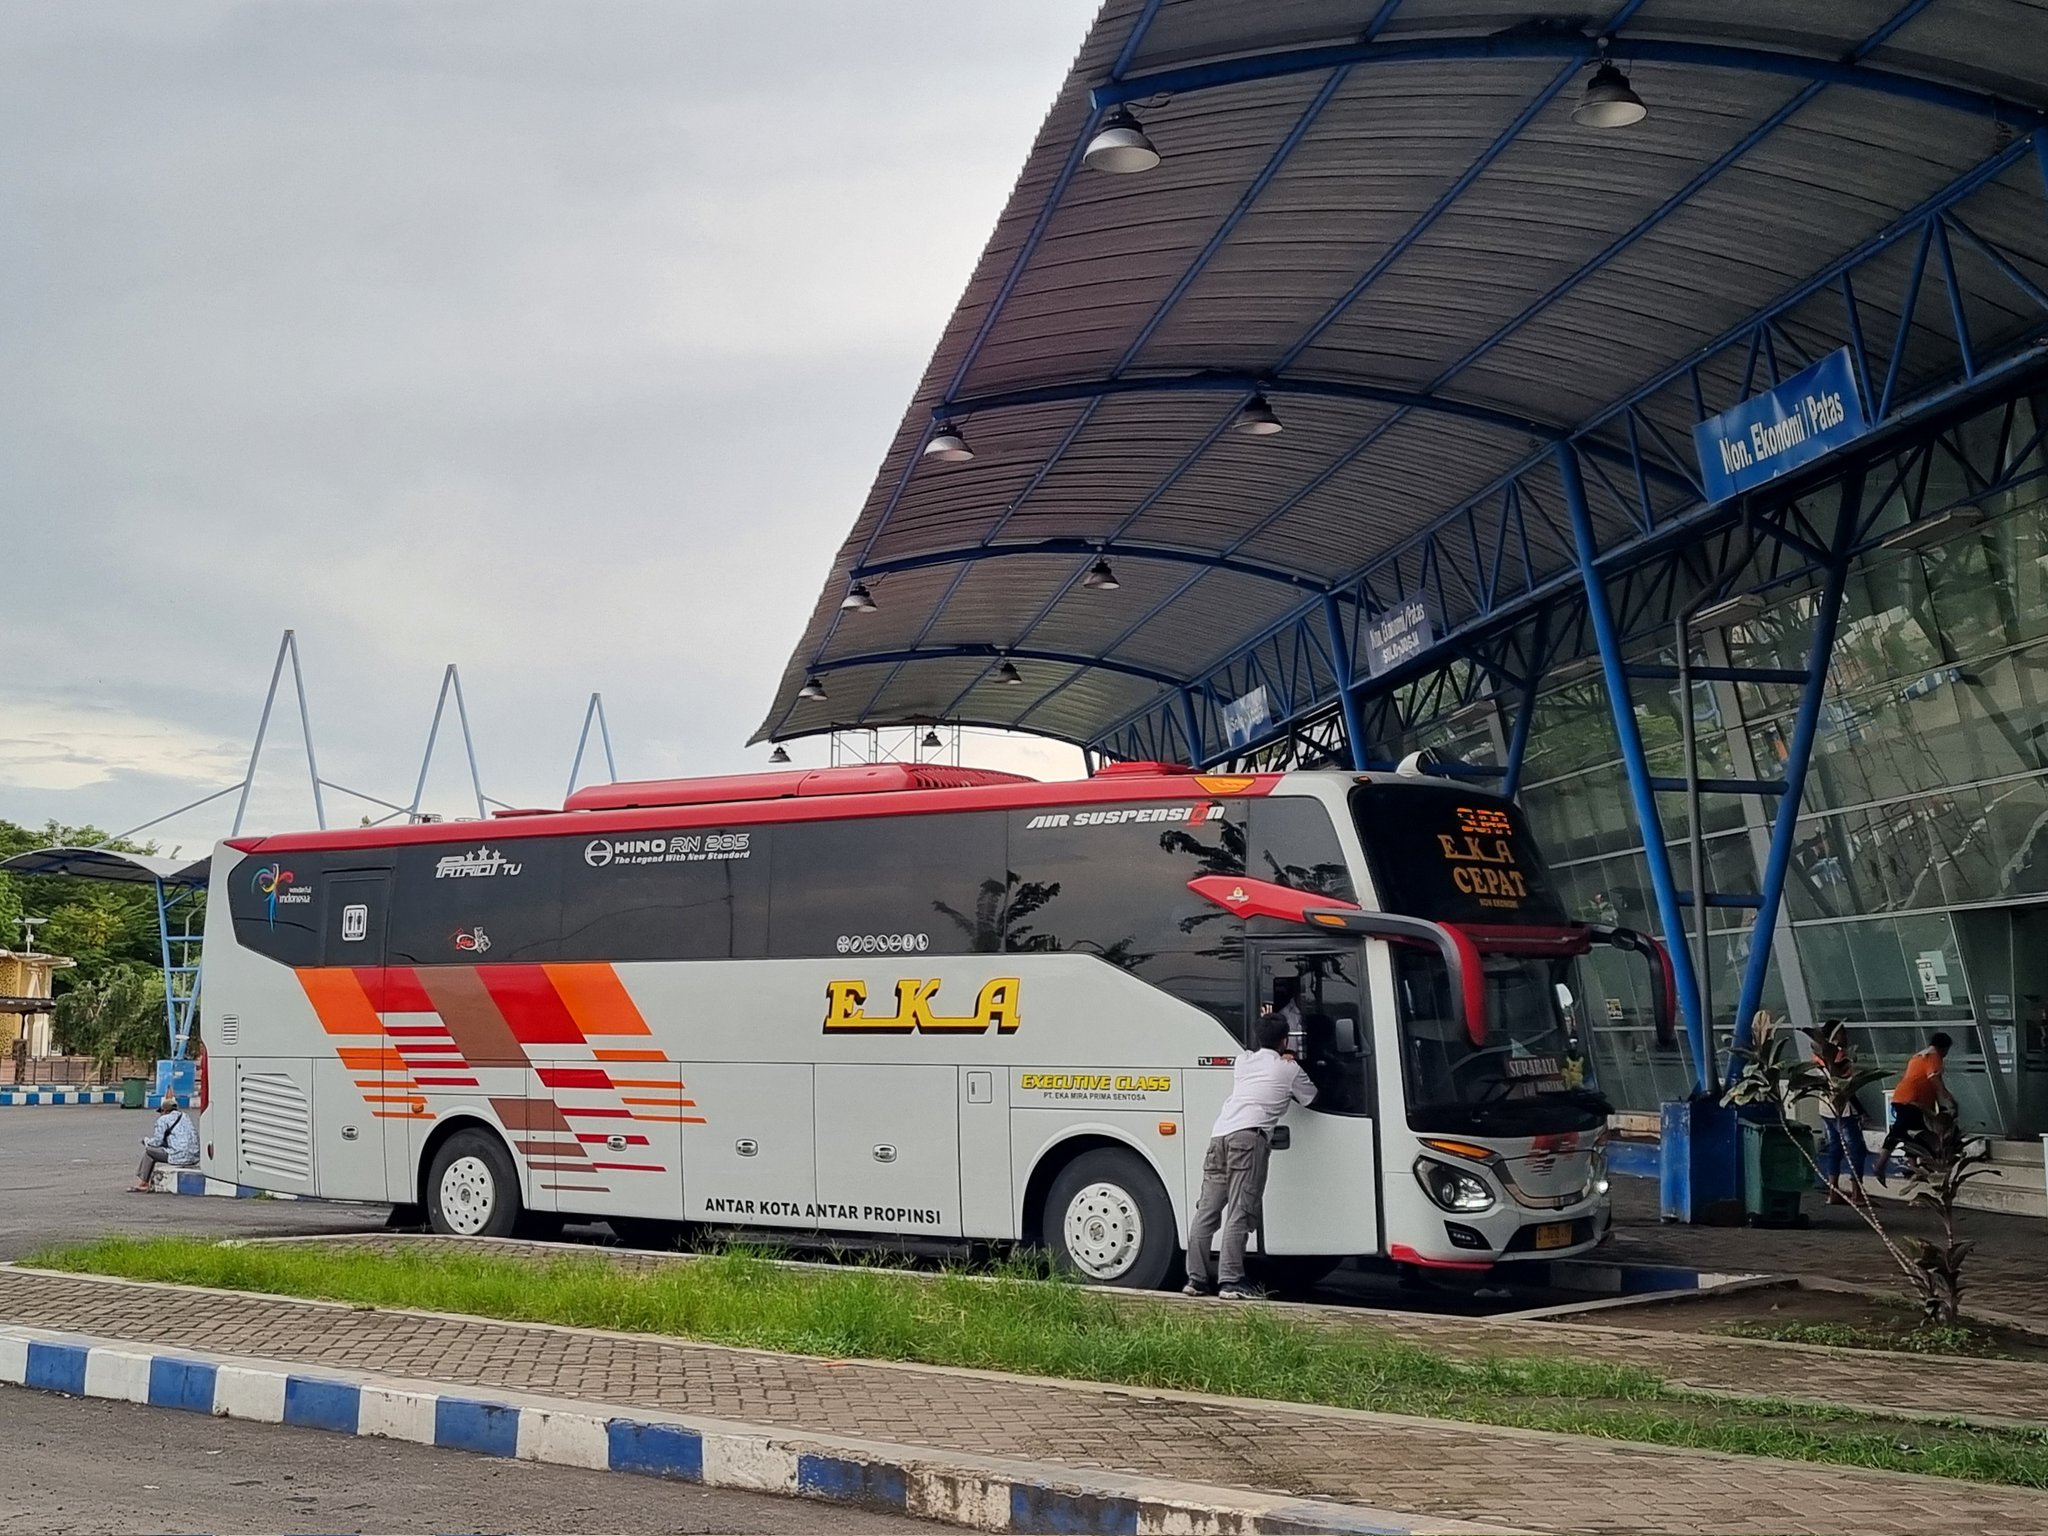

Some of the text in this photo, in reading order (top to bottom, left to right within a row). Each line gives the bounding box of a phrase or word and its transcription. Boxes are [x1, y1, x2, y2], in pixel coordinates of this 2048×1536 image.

[1719, 438, 1753, 475] Non.
[1750, 404, 1806, 462] Ekonomi
[1806, 390, 1845, 434] Patas
[1026, 801, 1226, 829] AIR SUSPENSION
[614, 833, 750, 854] HINO RN 285
[1436, 834, 1515, 863] EKA
[502, 863, 522, 876] TU
[614, 850, 750, 865] The Legend With New Standard
[1453, 866, 1526, 897] CEPAT
[822, 977, 1021, 1035] EKA
[1508, 1058, 1560, 1077] SURABAYA
[1021, 1074, 1170, 1091] EXECUTIVE CLASS
[1043, 1091, 1146, 1101] PT. EKA MIRA PRIMA SENTOSA
[705, 1198, 941, 1225] ANTAR KOTA ANTAR PROPINSI
